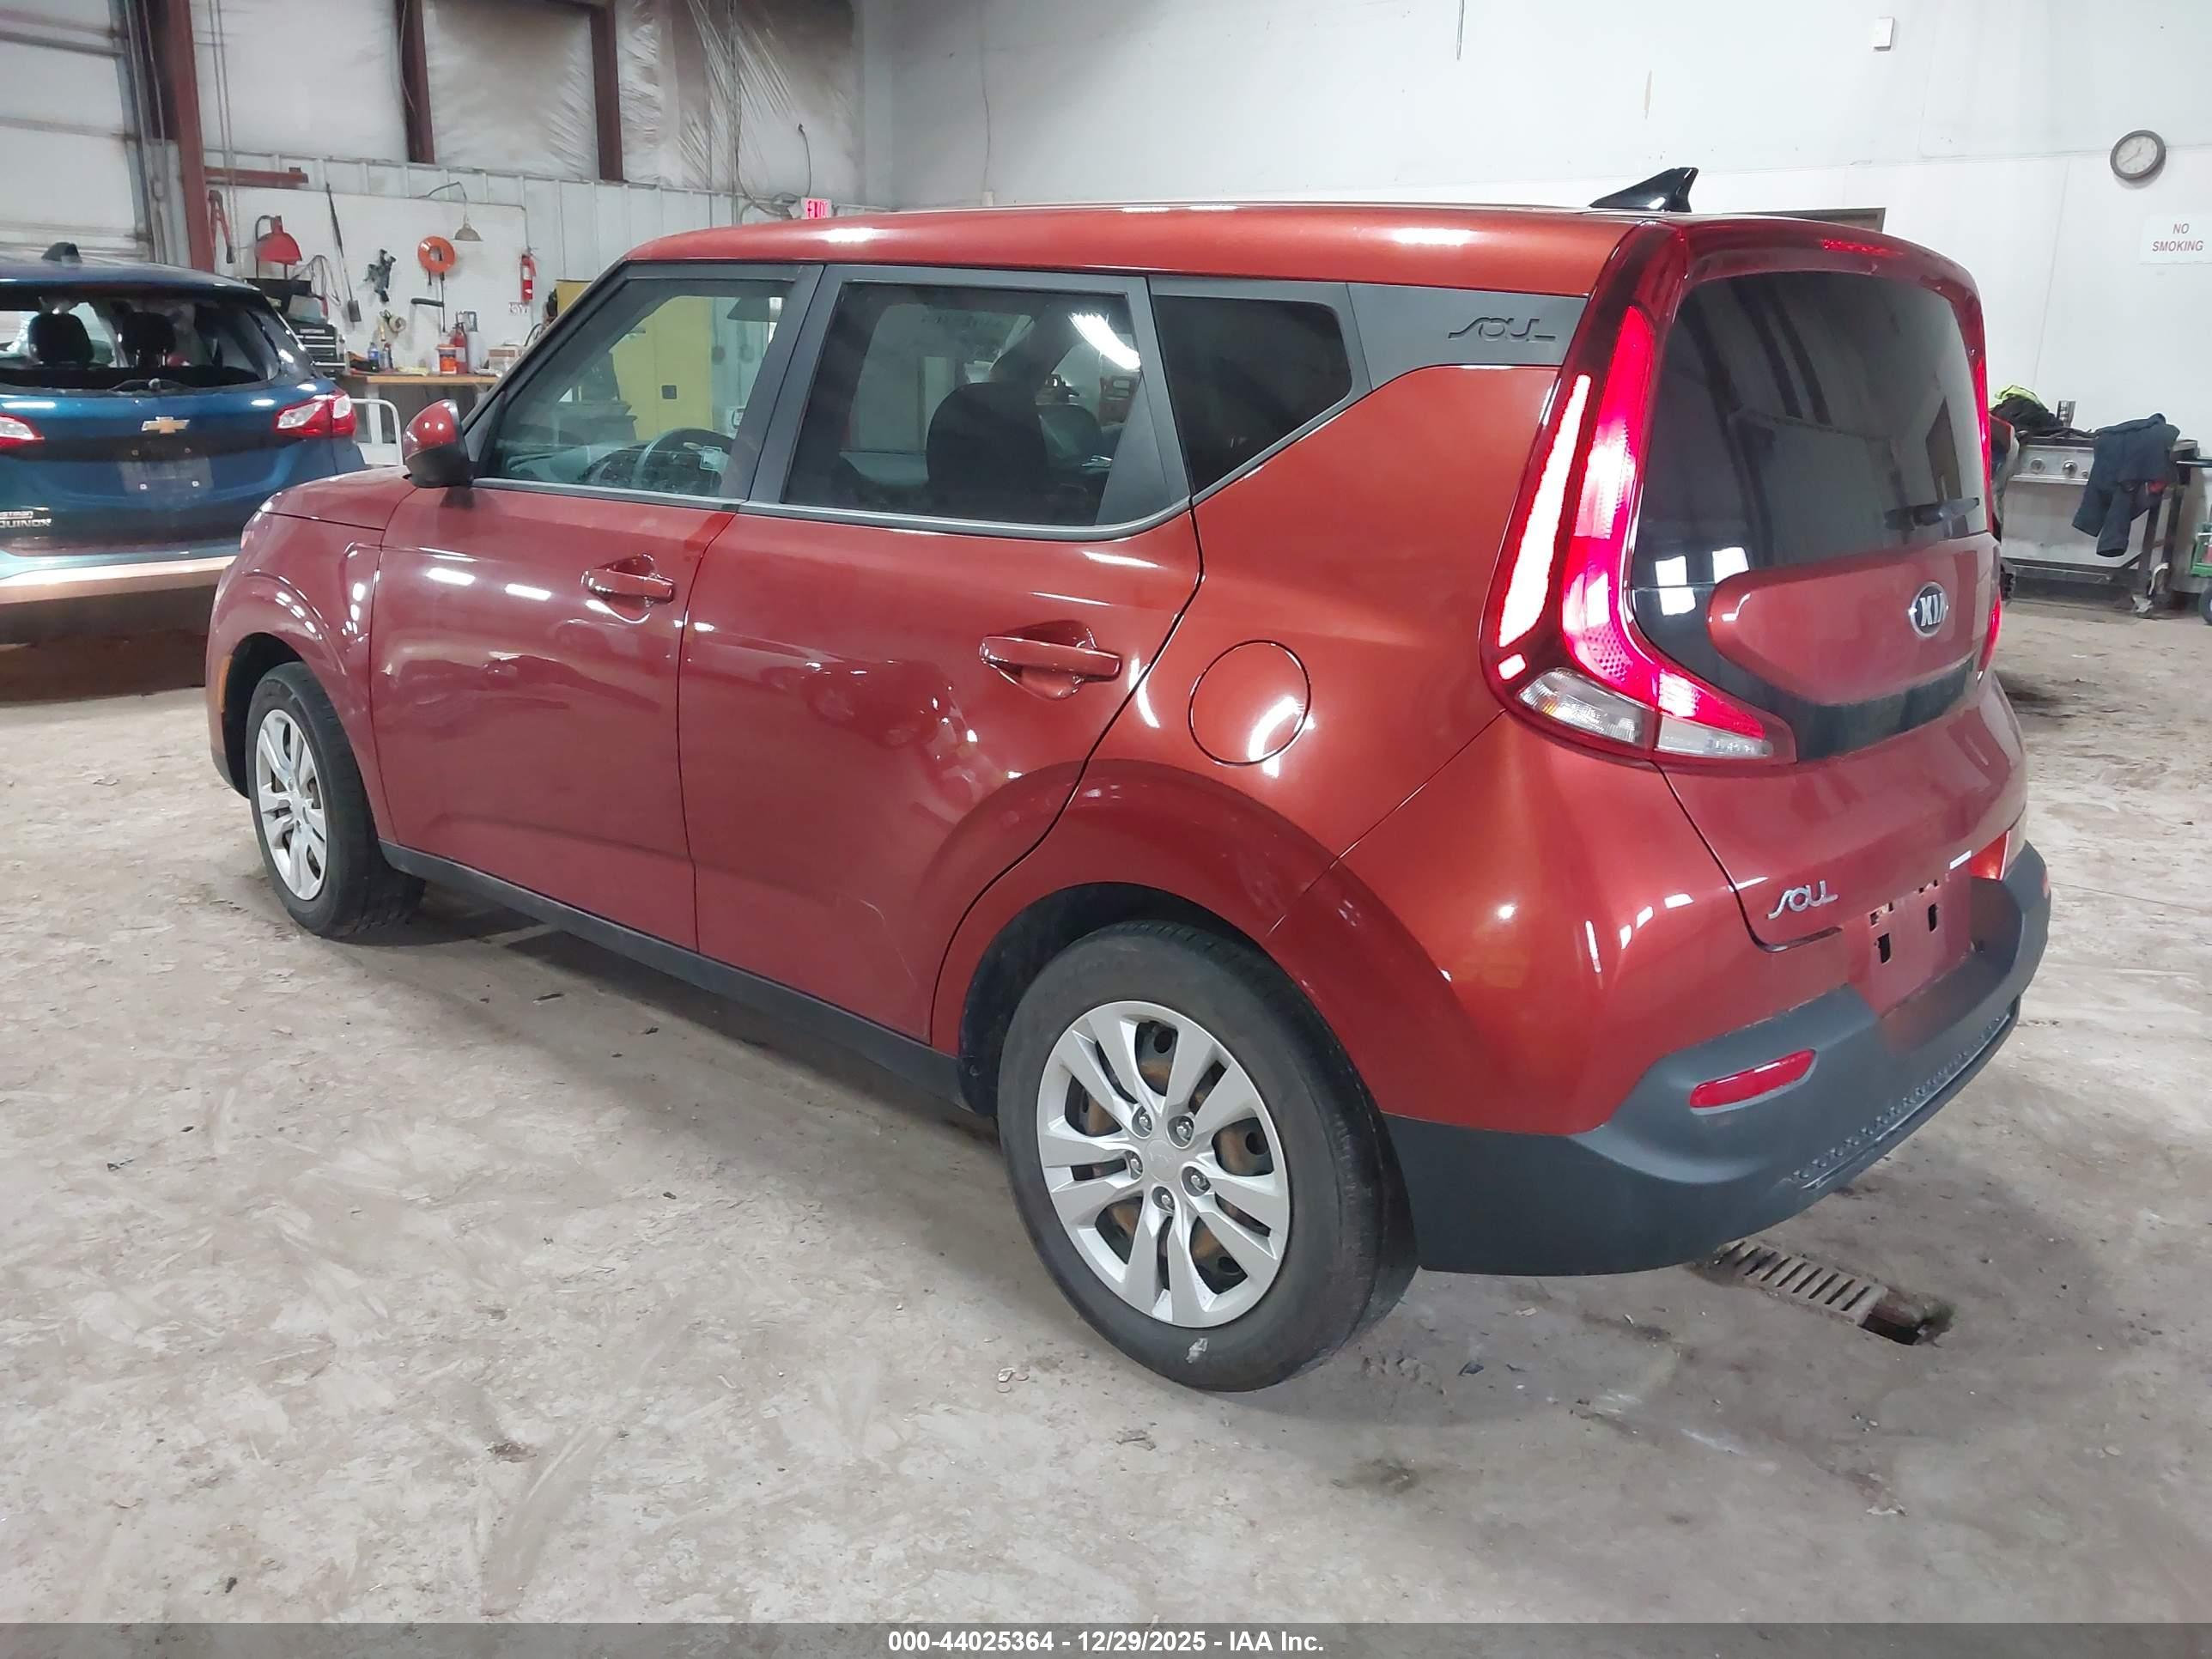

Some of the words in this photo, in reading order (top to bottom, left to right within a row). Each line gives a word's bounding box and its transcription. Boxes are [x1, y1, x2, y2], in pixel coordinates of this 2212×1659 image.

[2172, 223, 2190, 234] NO
[2152, 240, 2204, 252] SMOKING
[1767, 880, 1838, 919] SOUL
